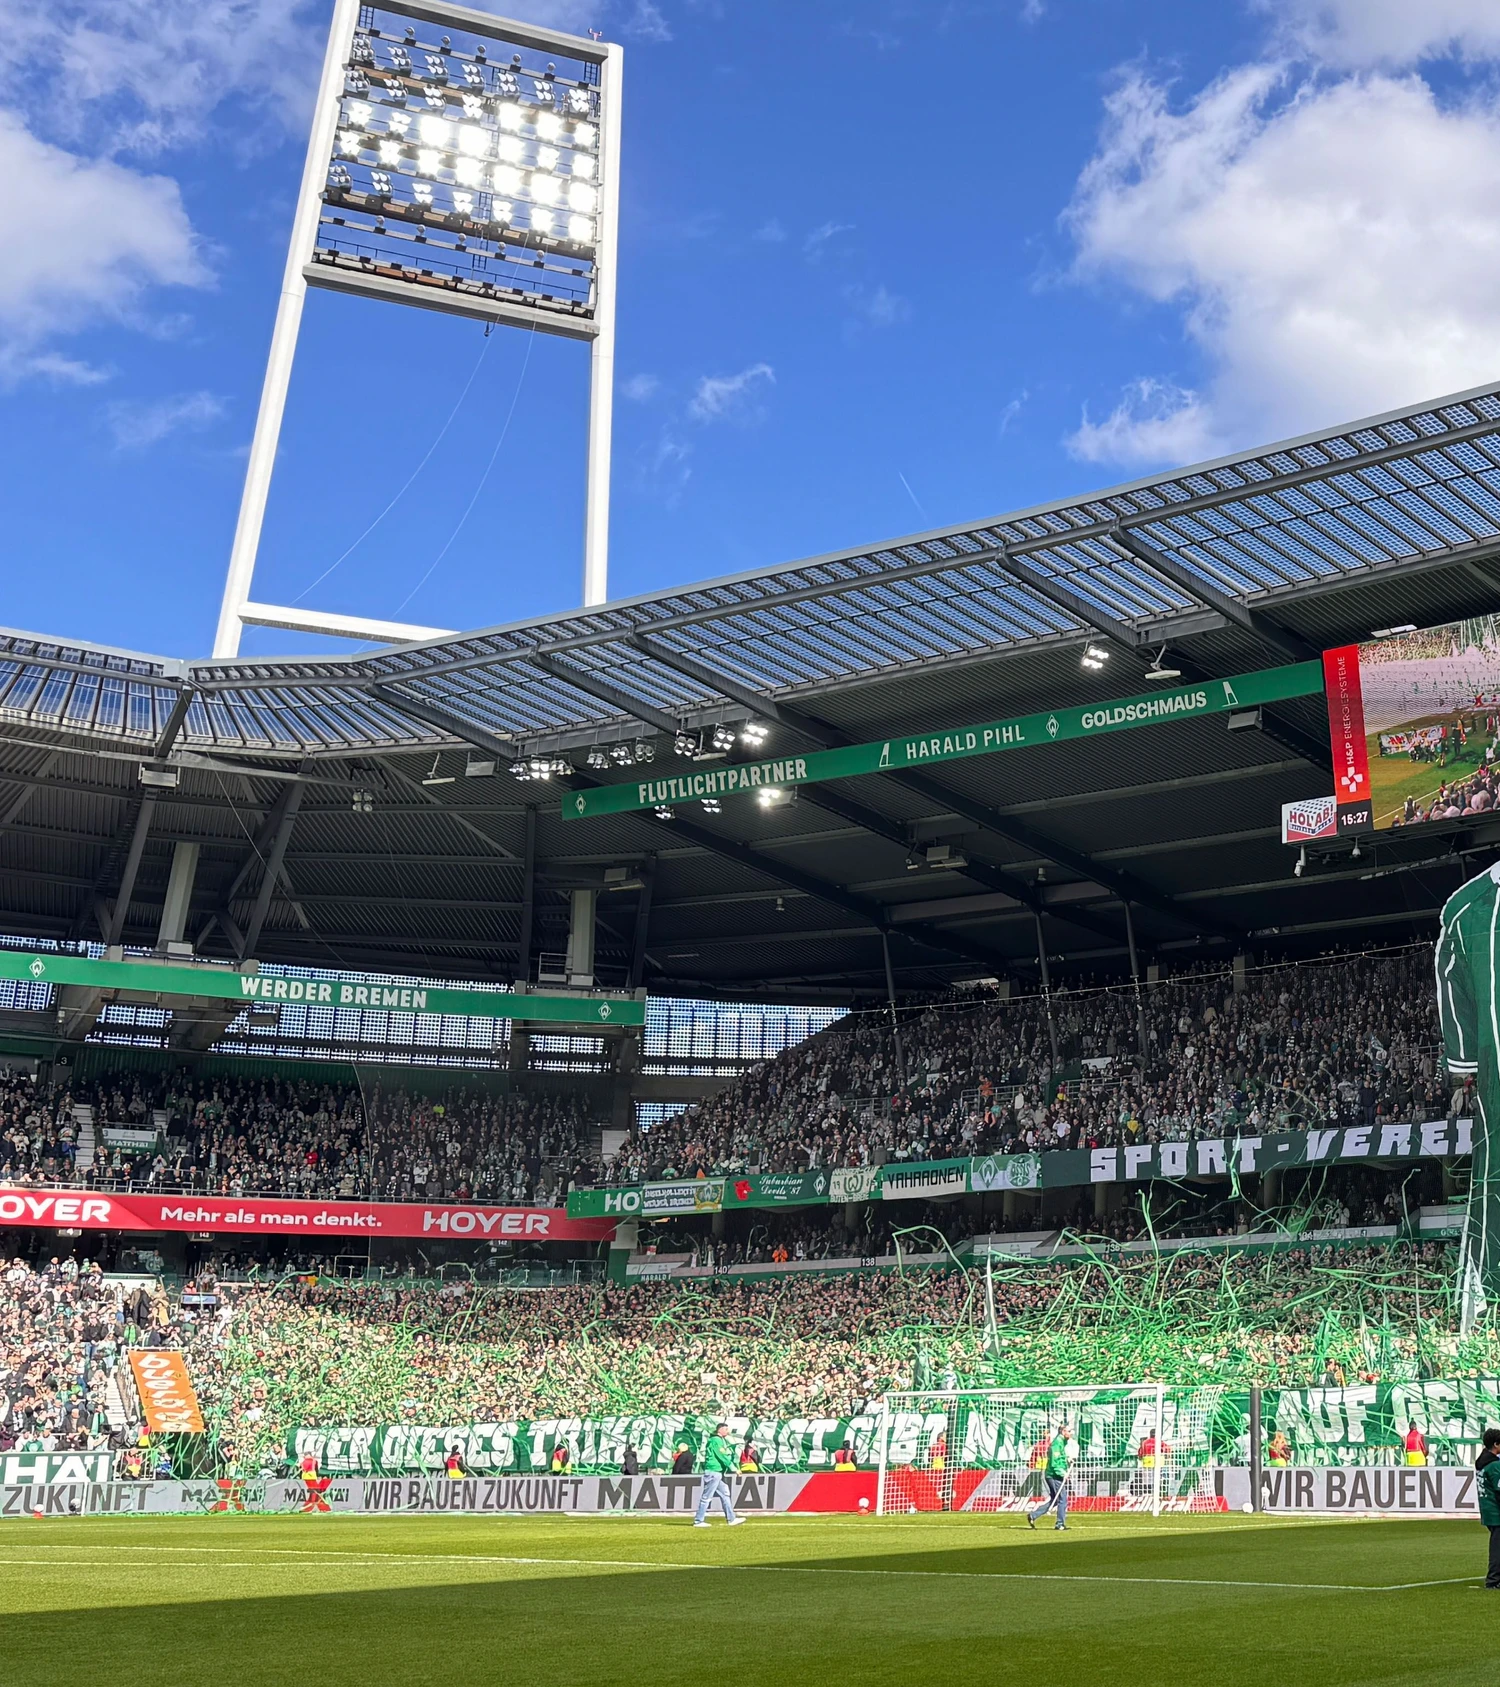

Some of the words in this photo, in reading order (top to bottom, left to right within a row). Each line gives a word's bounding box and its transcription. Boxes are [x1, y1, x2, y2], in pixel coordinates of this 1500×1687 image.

[1081, 690, 1208, 730] GOLDSCHMAUS
[1337, 656, 1352, 740] ENERGIESYSTEME
[905, 731, 977, 760] HARALD
[982, 723, 1026, 749] PIHL
[1345, 742, 1354, 765] H&P
[638, 759, 808, 804] FLUTLICHTPARTNER
[1341, 811, 1369, 826] 15:27
[240, 976, 332, 1004] WERDER
[339, 984, 427, 1009] BREMEN
[160, 1206, 222, 1223] Mehr
[224, 1209, 255, 1225] als
[261, 1212, 308, 1227] man
[312, 1210, 382, 1228] denkt.
[423, 1211, 550, 1235] HOYER
[861, 1257, 875, 1267] 138
[1276, 1385, 1377, 1445] AUF
[362, 1479, 402, 1511] WIR
[408, 1479, 478, 1510] BAUEN
[484, 1477, 583, 1510] ZUKUNFT
[1120, 1495, 1193, 1512] Zillrtal
[1250, 1471, 1314, 1509] WIR
[1327, 1471, 1443, 1509] BAUEN
